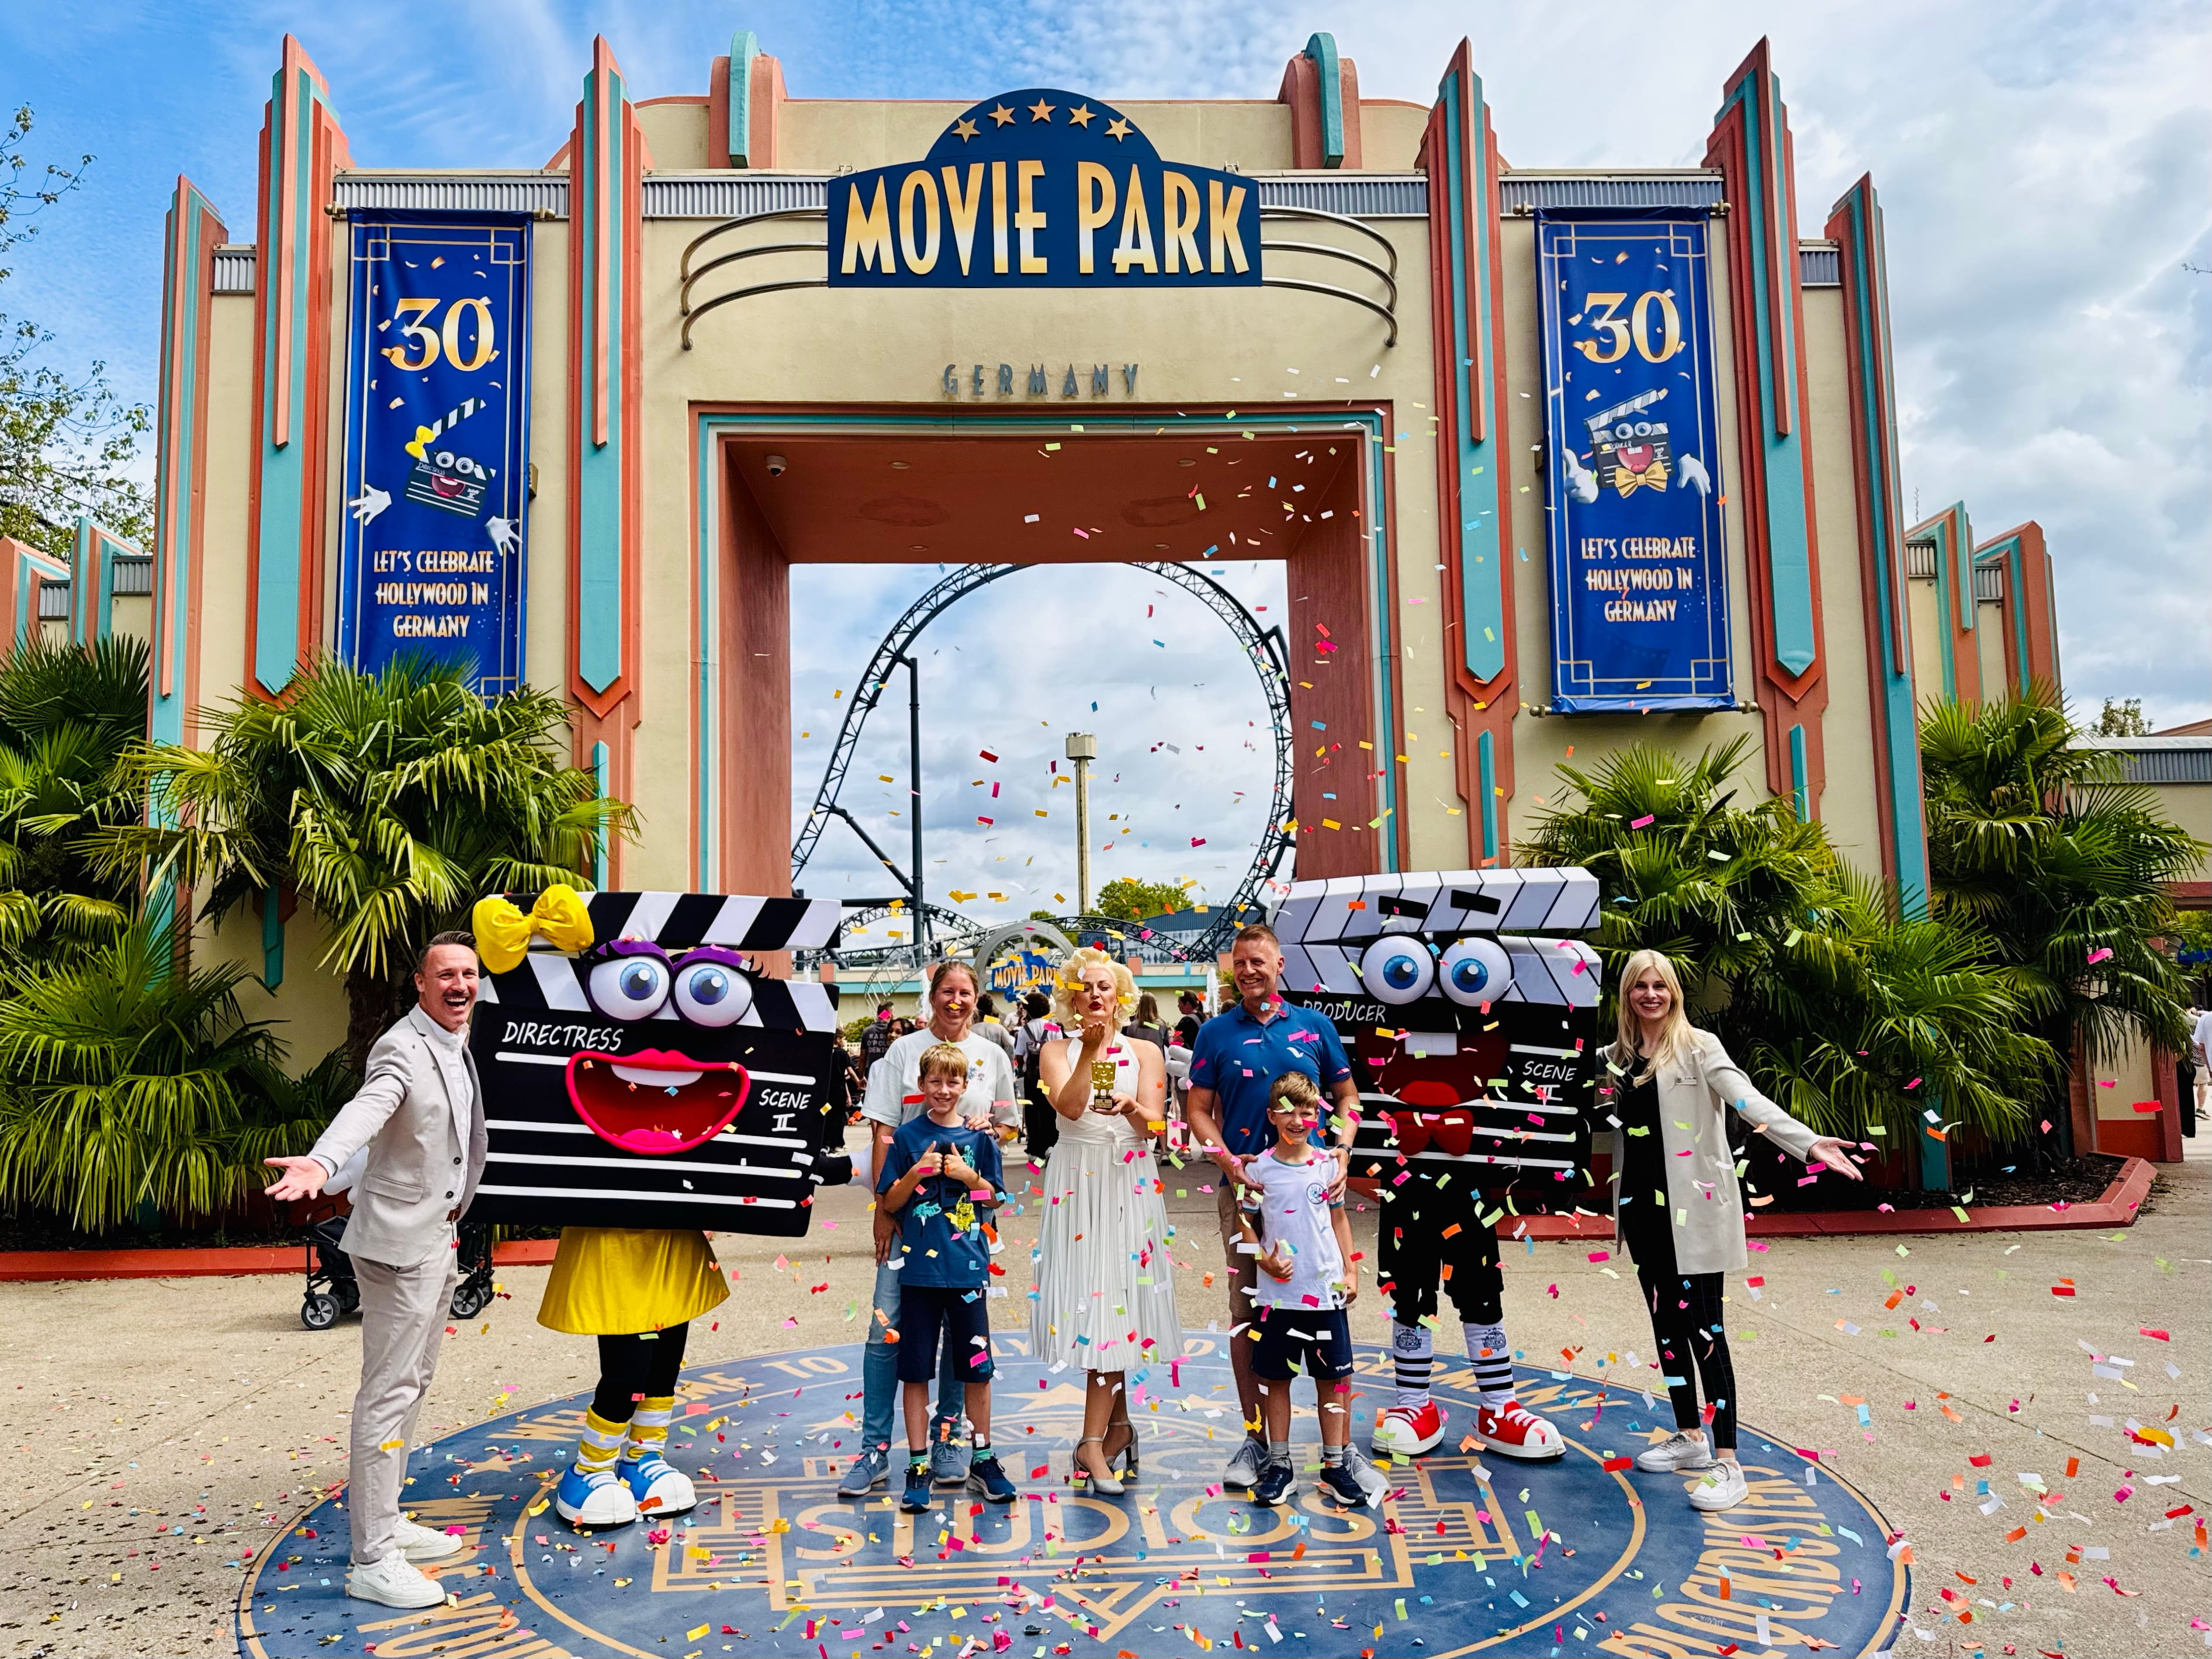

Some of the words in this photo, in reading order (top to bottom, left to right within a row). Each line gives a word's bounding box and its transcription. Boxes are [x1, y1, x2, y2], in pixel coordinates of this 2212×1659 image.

[841, 160, 1048, 276] MOVIE
[1078, 161, 1250, 276] PARK
[389, 297, 495, 372] 30
[1583, 290, 1681, 363] 30
[943, 362, 1140, 397] GERMANY
[1580, 538, 1618, 559] LET'S
[1621, 536, 1697, 559] CELEBRATE
[373, 550, 411, 573] LET'S
[416, 550, 494, 573] CELEBRATE
[1587, 569, 1673, 591] HOLLYWOOD
[1677, 568, 1693, 590] IN
[376, 582, 468, 605] HOLLYWOOD
[471, 582, 489, 605] IN
[1604, 600, 1677, 622] GERMANY
[393, 615, 470, 638] GERMANY
[994, 965, 1029, 988] MOVIE
[502, 1021, 624, 1051] DIRECTRESS
[1522, 1061, 1577, 1081] SCENE
[759, 1088, 812, 1110] SCENE
[771, 1113, 798, 1132] II
[761, 1356, 850, 1379] TO
[796, 1491, 1377, 1559] STUDIOS
